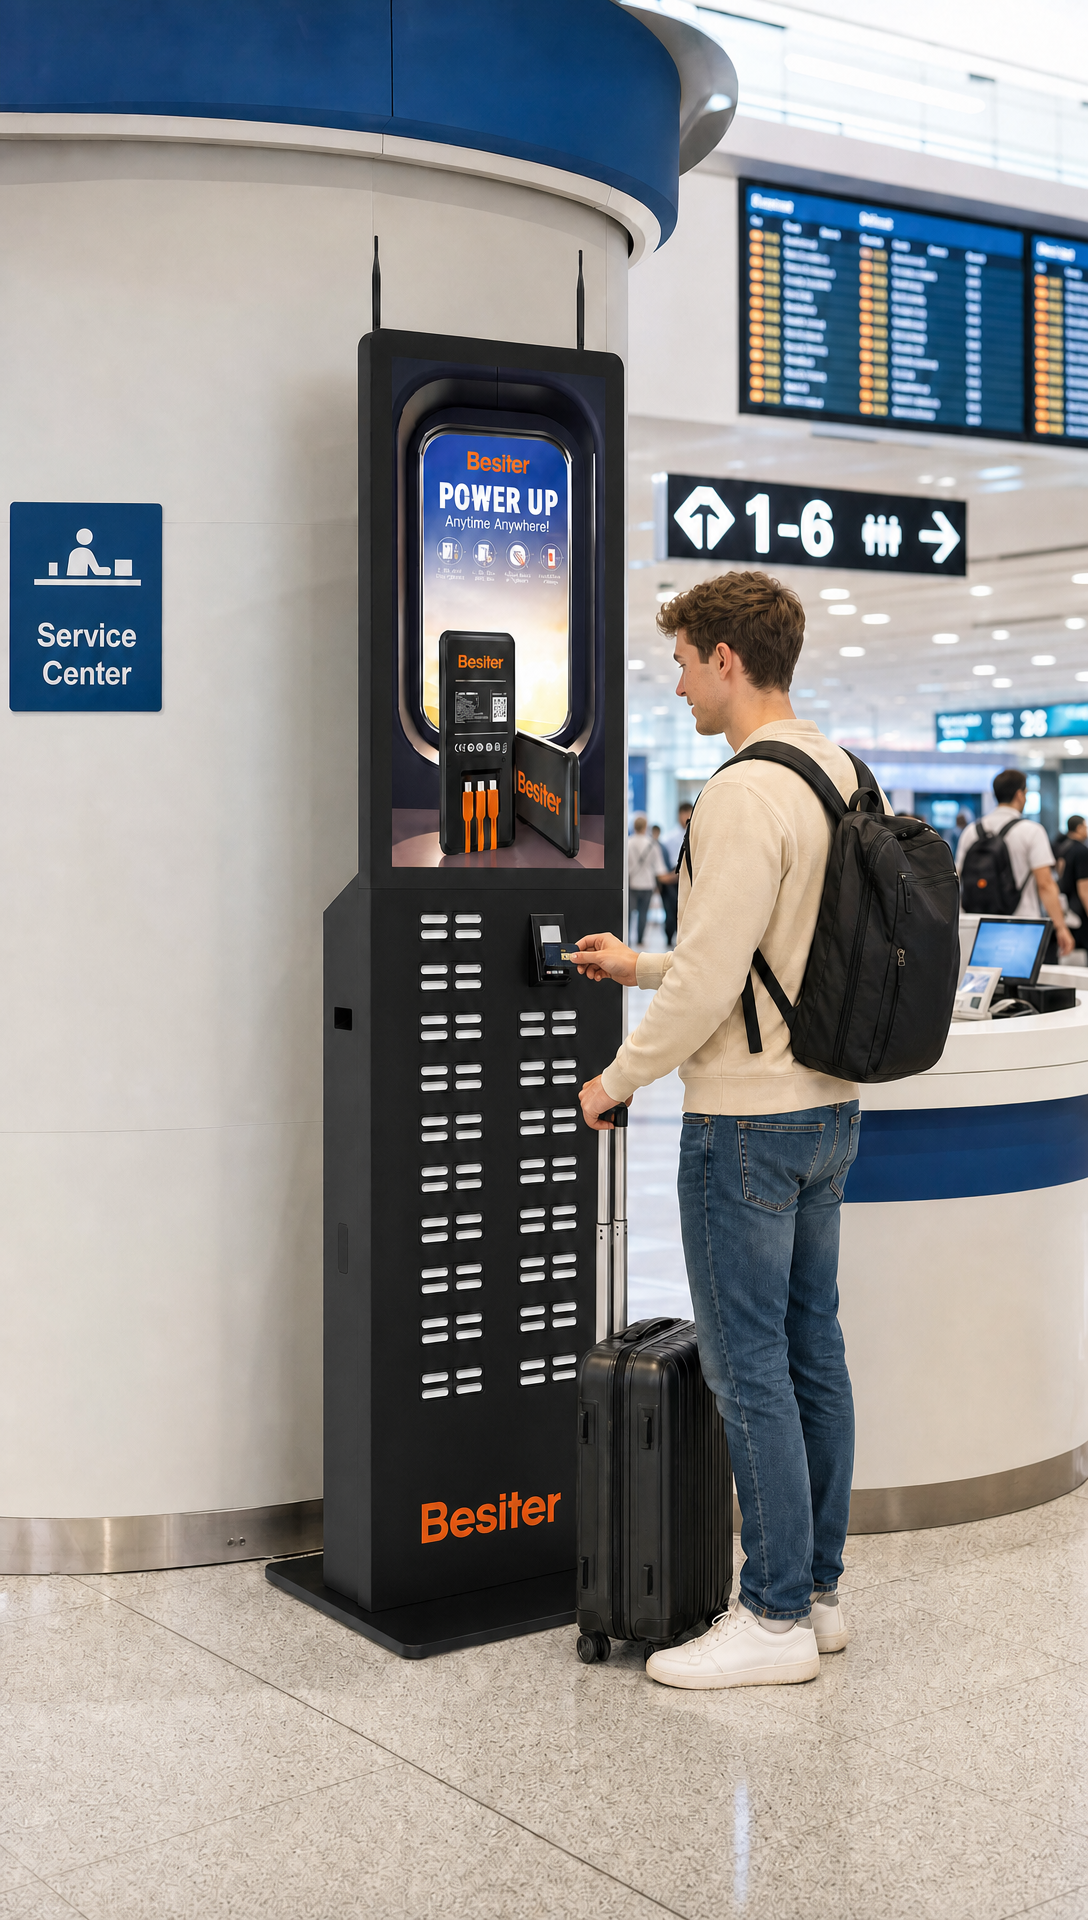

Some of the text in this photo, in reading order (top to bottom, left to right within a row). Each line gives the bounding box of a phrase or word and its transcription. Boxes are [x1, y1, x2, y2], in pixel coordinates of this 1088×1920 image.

[467, 451, 530, 475] Besiter
[439, 481, 559, 516] POWER UP
[445, 515, 550, 534] Anytime Anywhere!
[745, 493, 835, 558] 1-6
[37, 622, 137, 648] Service
[42, 660, 133, 686] Center
[458, 654, 504, 669] Besiter
[518, 770, 562, 816] Besiter
[421, 1491, 562, 1545] Besiter
